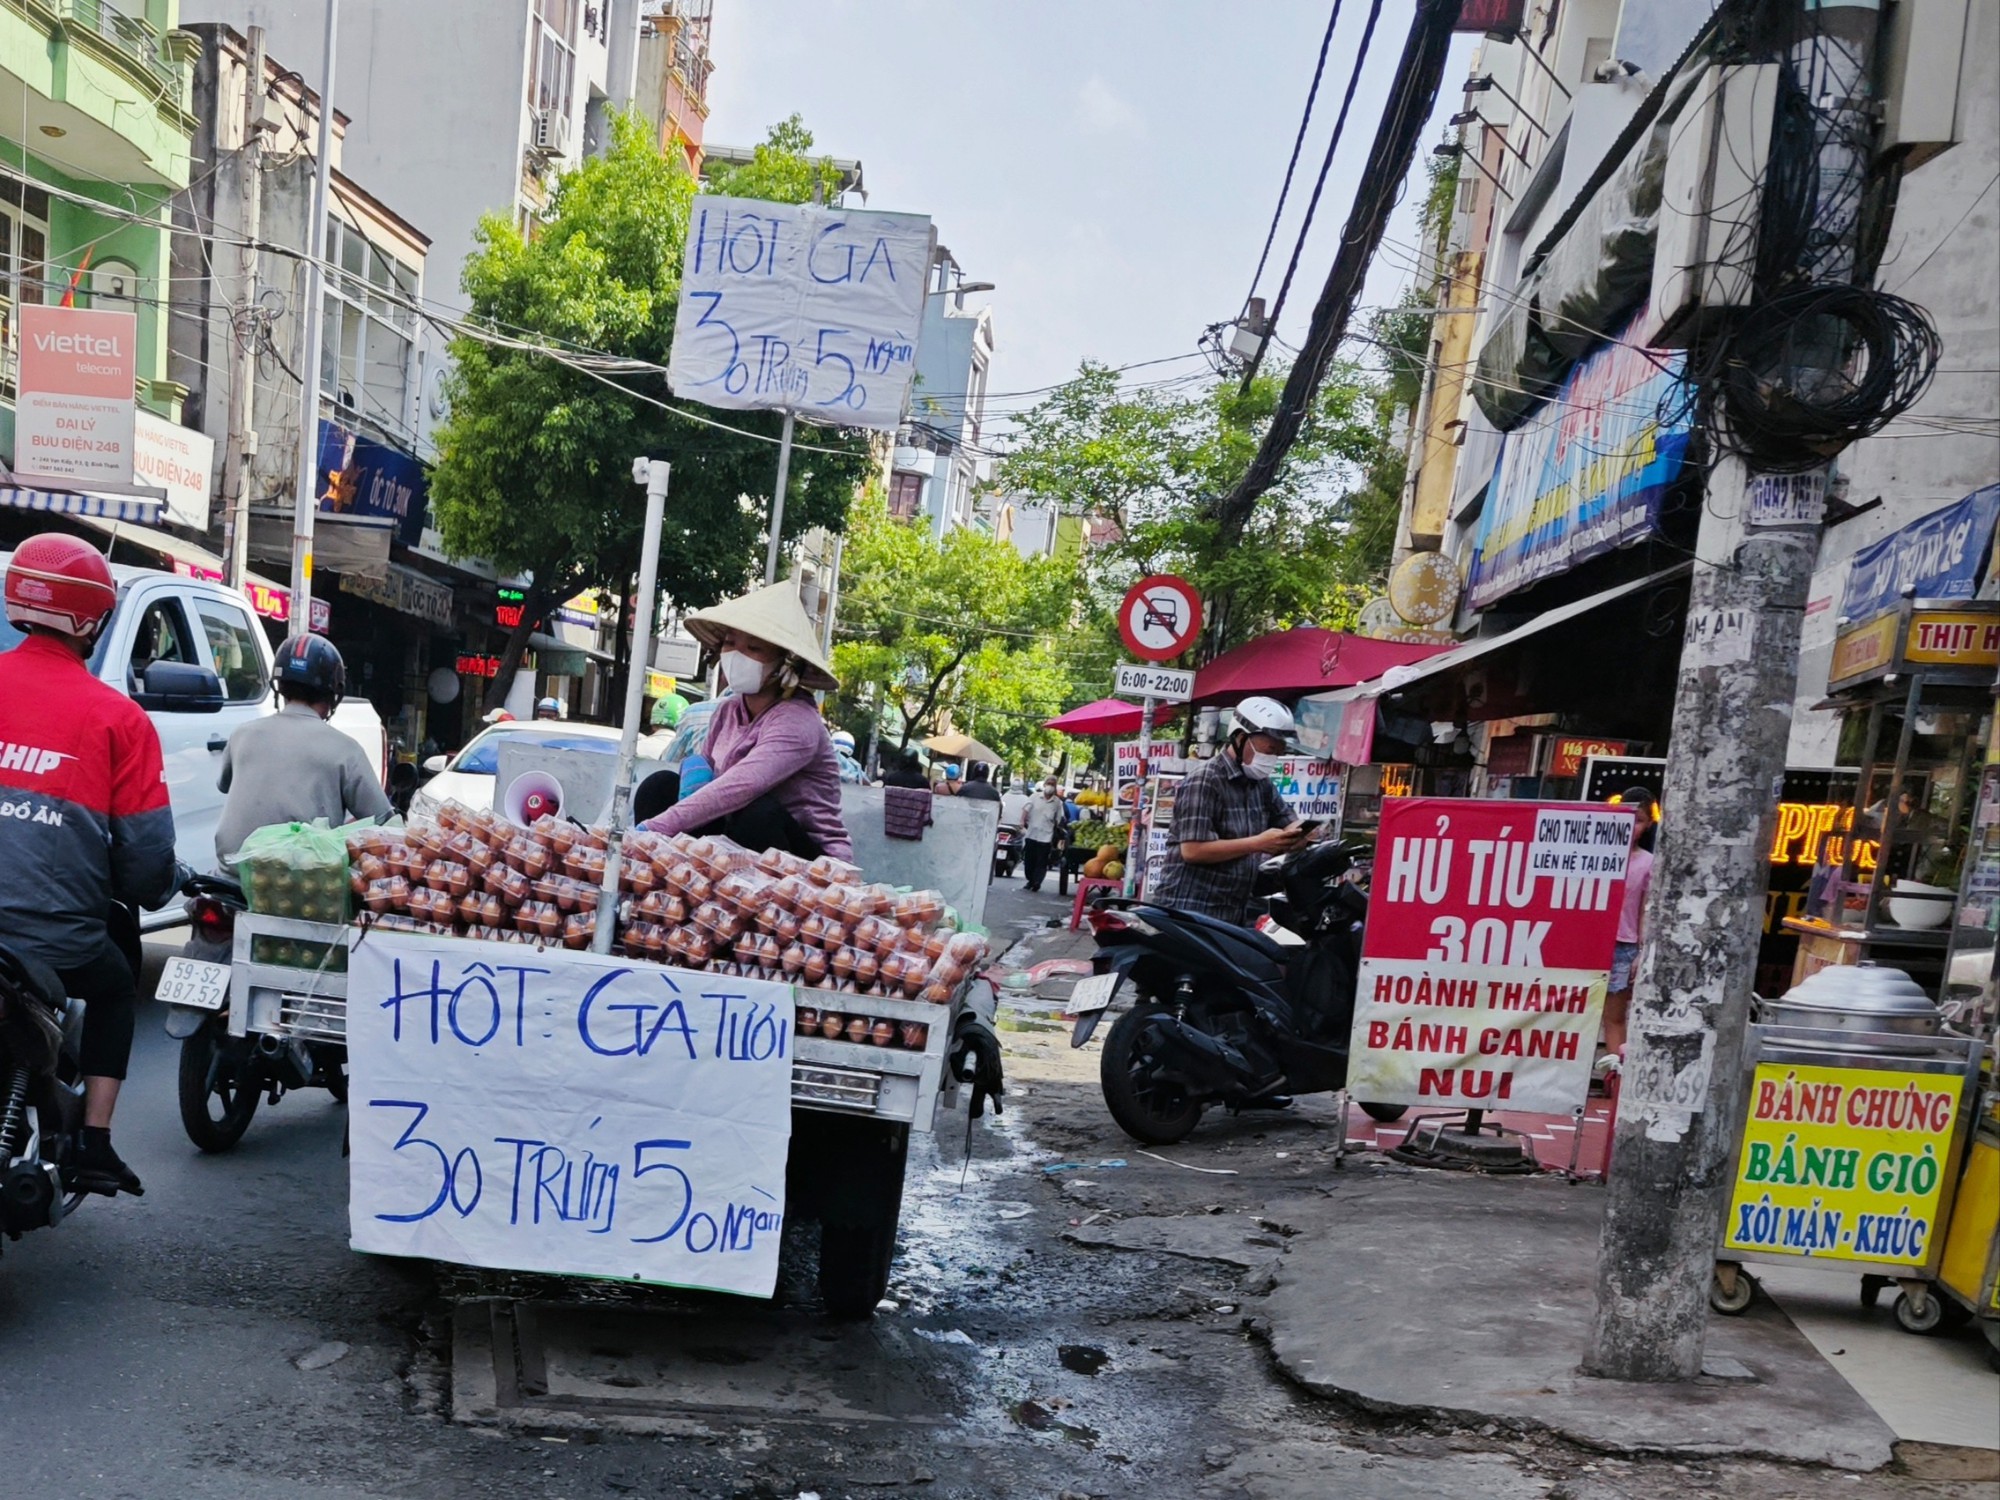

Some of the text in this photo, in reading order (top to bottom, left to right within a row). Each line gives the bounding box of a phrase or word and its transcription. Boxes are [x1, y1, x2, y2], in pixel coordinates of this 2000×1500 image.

[33, 331, 122, 358] viettel
[76, 363, 122, 376] telecom
[56, 417, 96, 431] ĐẠI LÝ
[91, 405, 120, 414] VIETTEL
[61, 436, 93, 452] ĐIỆN
[96, 441, 120, 453] 248
[164, 437, 190, 455] VIETTEL
[156, 457, 181, 484] ĐIỆN
[183, 468, 202, 491] 248
[1918, 623, 1978, 656] THỊT
[1562, 741, 1584, 756] Há
[0, 800, 63, 827] ĐỒ ĂN
[1538, 814, 1631, 846] CHO THUÊ PHÒNG
[1386, 814, 1454, 905] HỦ
[1466, 825, 1538, 909] TÍU
[1533, 849, 1625, 874] LIÊN HỆ TẠI ĐÂY
[1425, 915, 1553, 968] 30K
[174, 961, 222, 985] 59-S2
[161, 980, 221, 1006] 987.52
[1373, 970, 1589, 1014] HOÀNH THÁNH
[577, 968, 699, 1059] GÀ
[1367, 1016, 1580, 1060] BÁNH CANH
[1417, 1068, 1514, 1100] NUI
[1755, 1071, 1951, 1133] BÁNH CHƯNG
[368, 1099, 483, 1222] 30
[1744, 1133, 1938, 1196] BÁNH GIÒ
[1734, 1193, 1782, 1244] XÔI
[1782, 1198, 1842, 1256] MẶN
[1853, 1206, 1927, 1257] KHÚC
